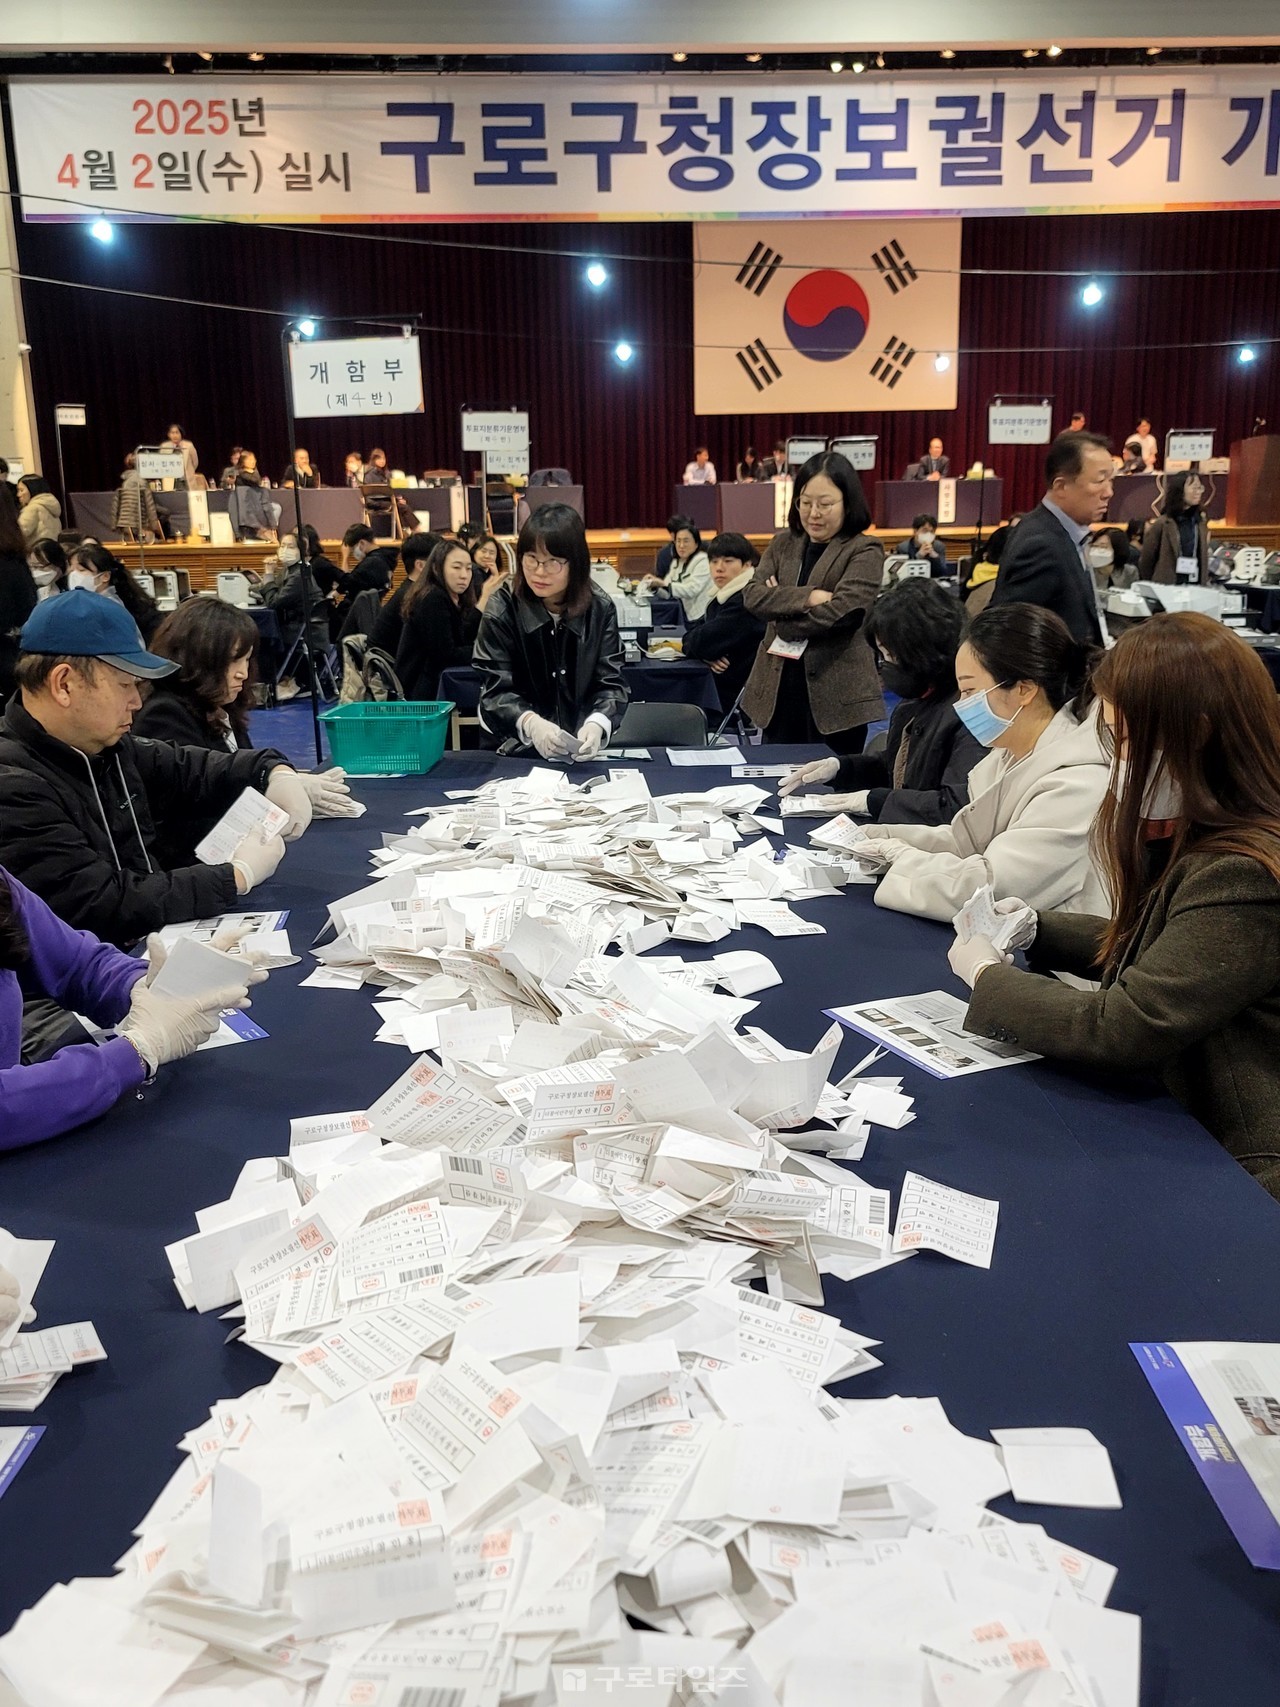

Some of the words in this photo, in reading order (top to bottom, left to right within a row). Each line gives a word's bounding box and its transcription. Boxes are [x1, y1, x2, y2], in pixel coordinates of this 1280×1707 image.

[132, 97, 267, 137] 2025년
[380, 88, 1186, 194] 구로구청장보궐선거
[57, 149, 118, 191] 4월
[132, 148, 264, 193] 2일(수)
[277, 150, 352, 193] 실시
